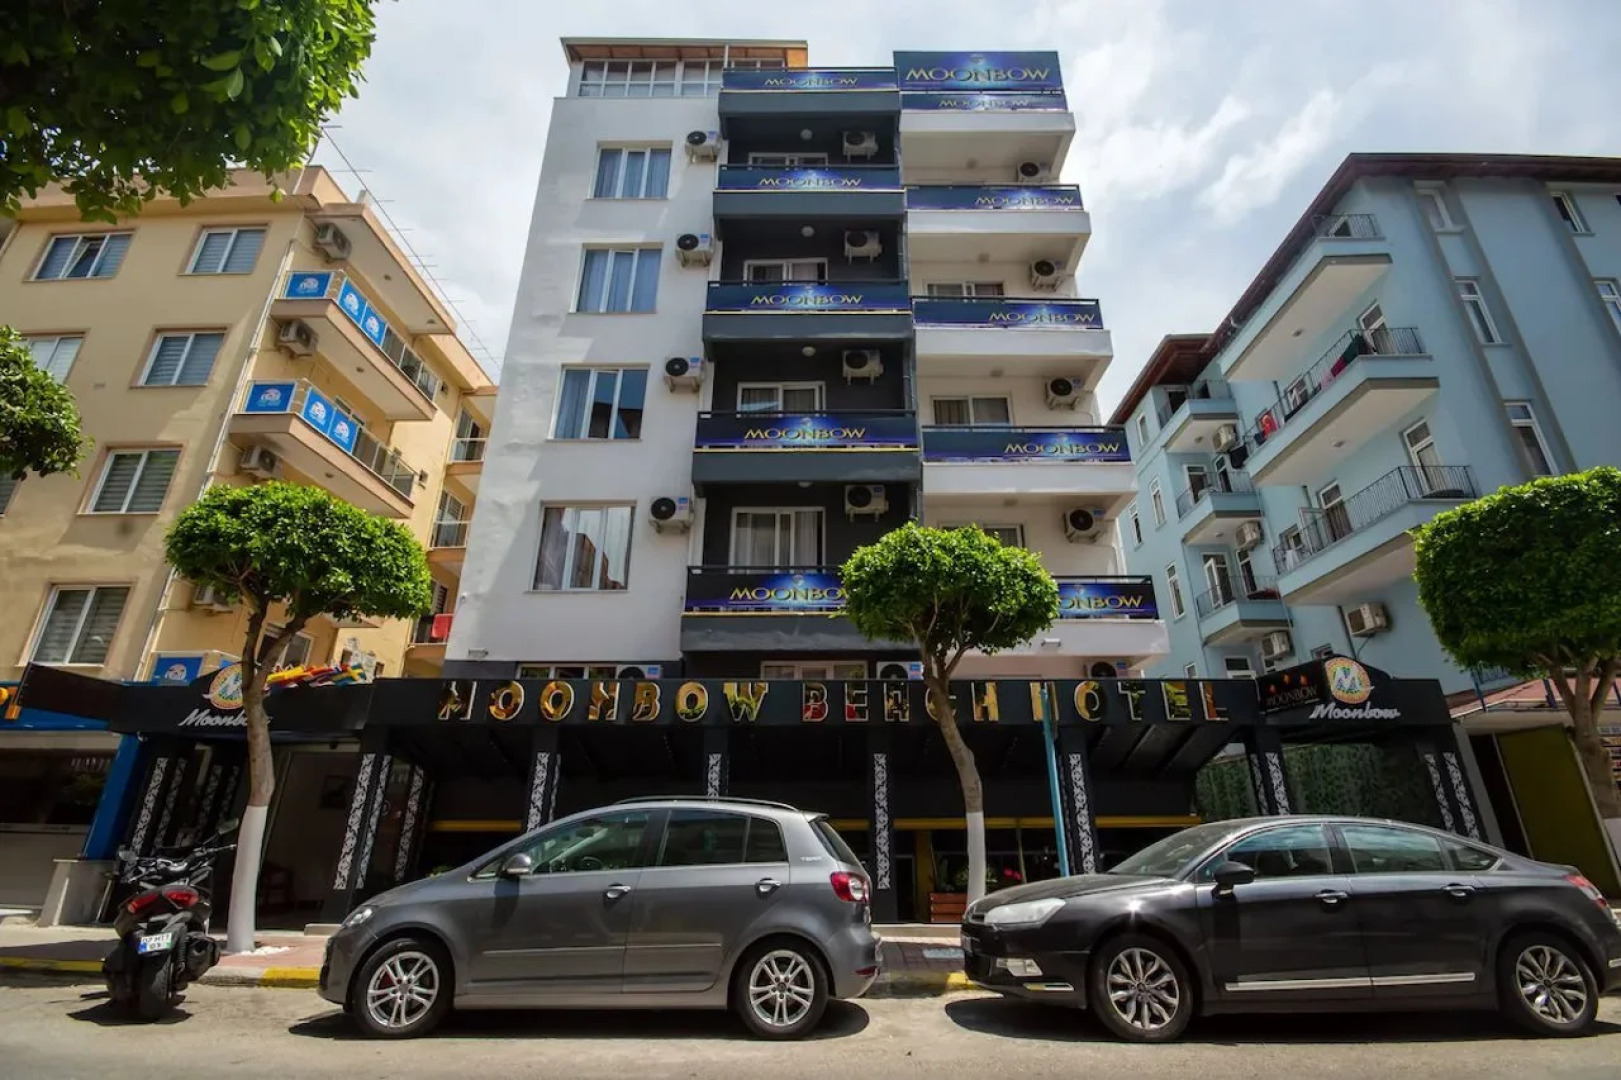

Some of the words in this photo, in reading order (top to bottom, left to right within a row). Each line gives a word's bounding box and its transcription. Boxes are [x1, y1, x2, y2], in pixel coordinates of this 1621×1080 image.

[905, 67, 1050, 82] MOONBOW
[764, 77, 858, 87] MOONBOW
[938, 99, 1029, 108] MOONBOW
[758, 177, 862, 188] MOONBOW
[974, 195, 1075, 206] MOONBOW
[750, 294, 863, 306] MOONBOW
[988, 311, 1096, 323] MOONBOW
[743, 427, 867, 440] MOONBOW
[1003, 442, 1120, 455] MOONBOW
[1059, 595, 1143, 610] ONBOW
[438, 680, 769, 723] MOONBOW
[1030, 680, 1230, 723] HOTEL
[1309, 701, 1401, 720] Moonbow
[178, 708, 273, 727] Moonb
